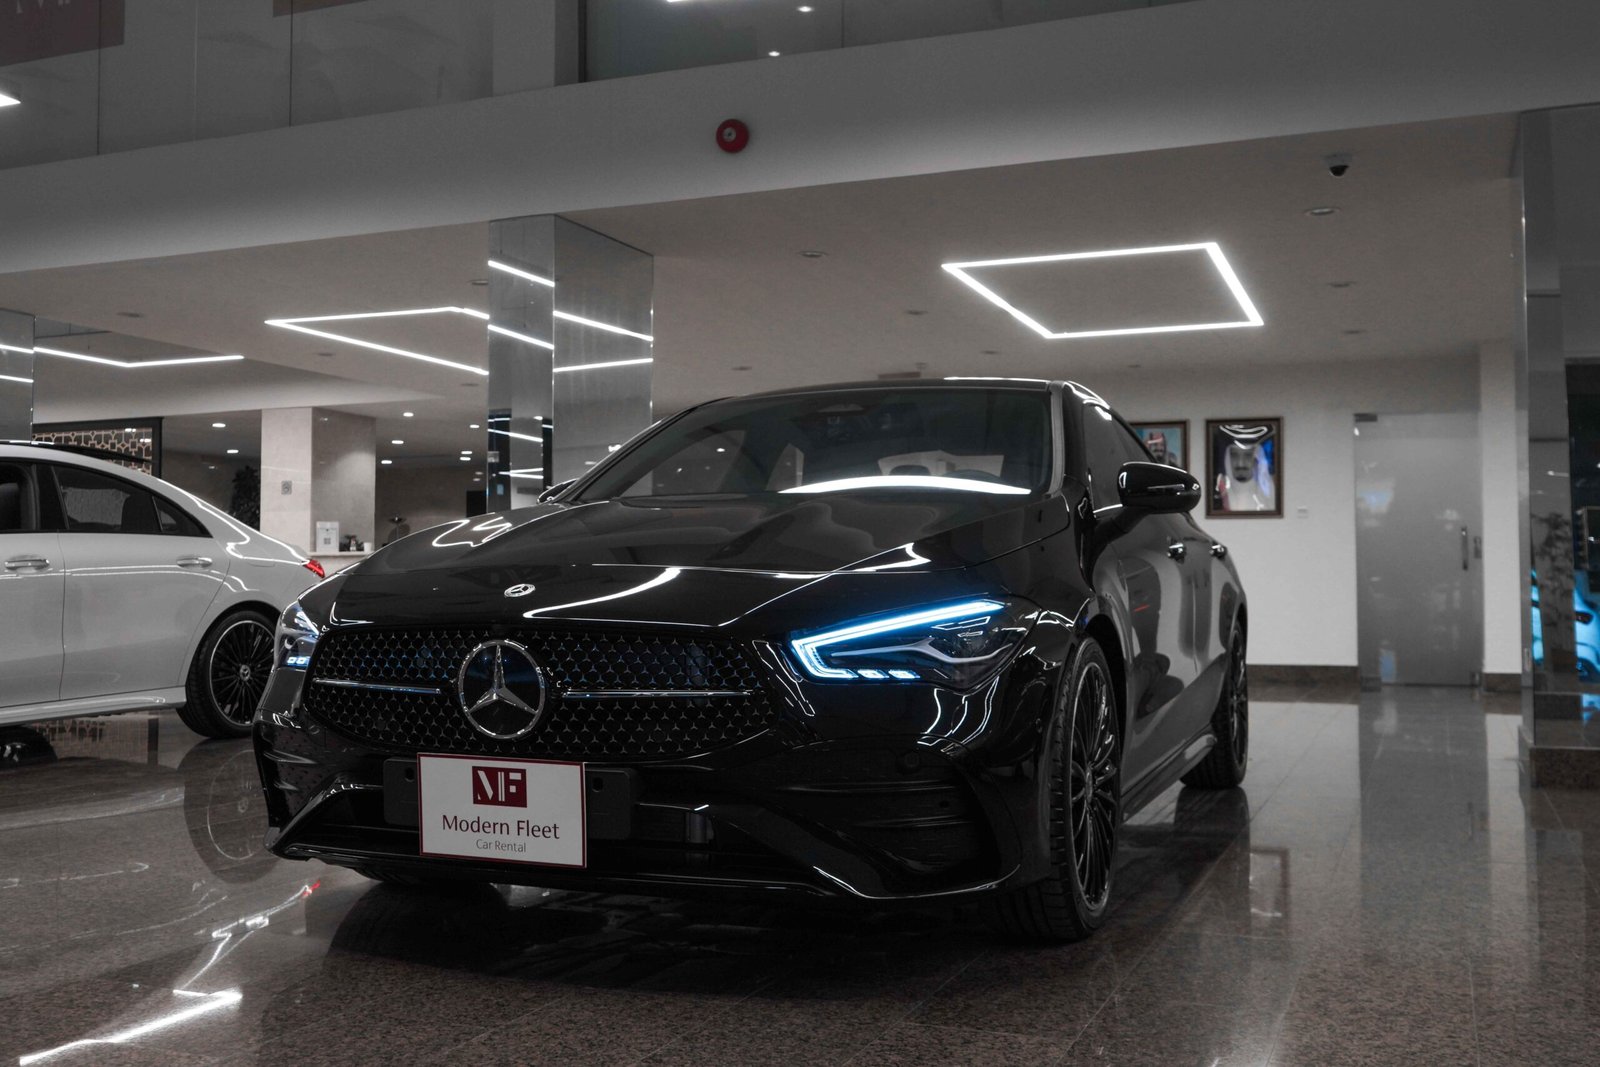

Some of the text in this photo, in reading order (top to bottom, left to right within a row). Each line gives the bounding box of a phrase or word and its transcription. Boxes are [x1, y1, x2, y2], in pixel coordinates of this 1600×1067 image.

[442, 815, 560, 839] Modern Fleet
[476, 839, 526, 853] Car Rental
